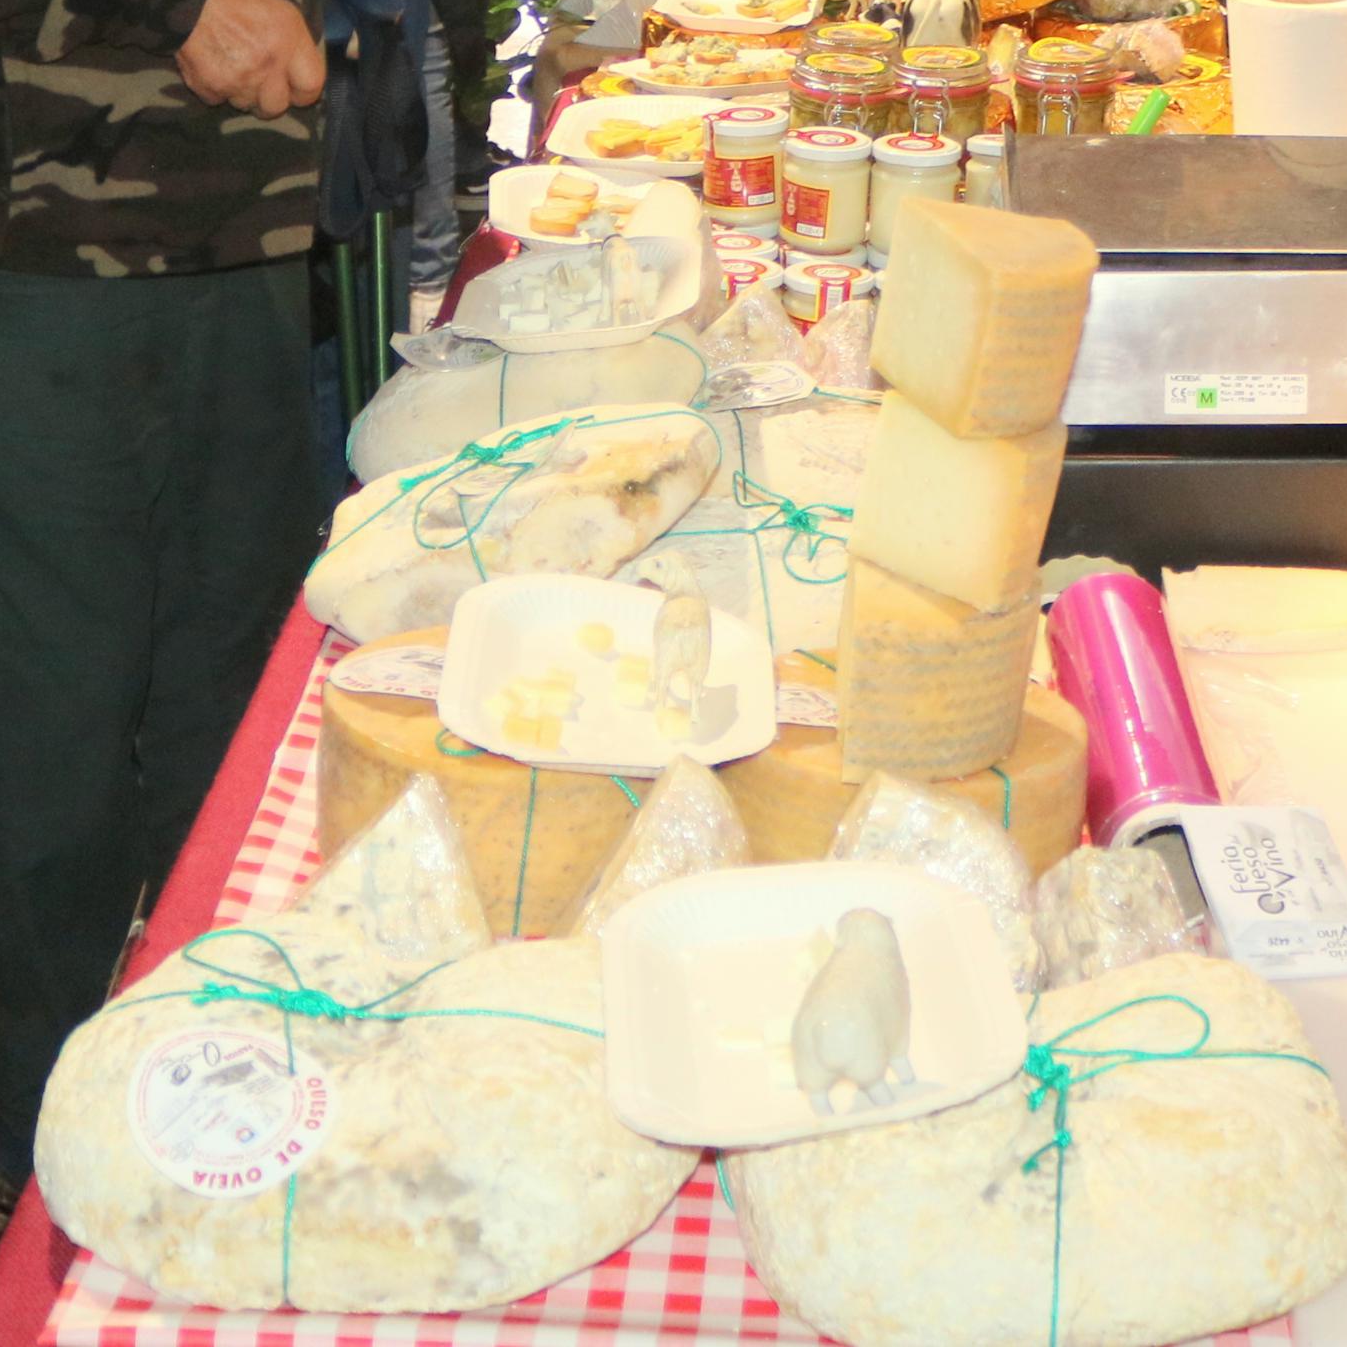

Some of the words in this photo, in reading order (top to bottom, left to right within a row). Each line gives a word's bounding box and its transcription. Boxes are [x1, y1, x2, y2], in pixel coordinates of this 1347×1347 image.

[1200, 392, 1213, 403] M
[1260, 837, 1297, 888] Vino
[305, 1077, 328, 1130] QUESO
[274, 1139, 304, 1166] DE
[191, 1166, 263, 1189] OVEJA
